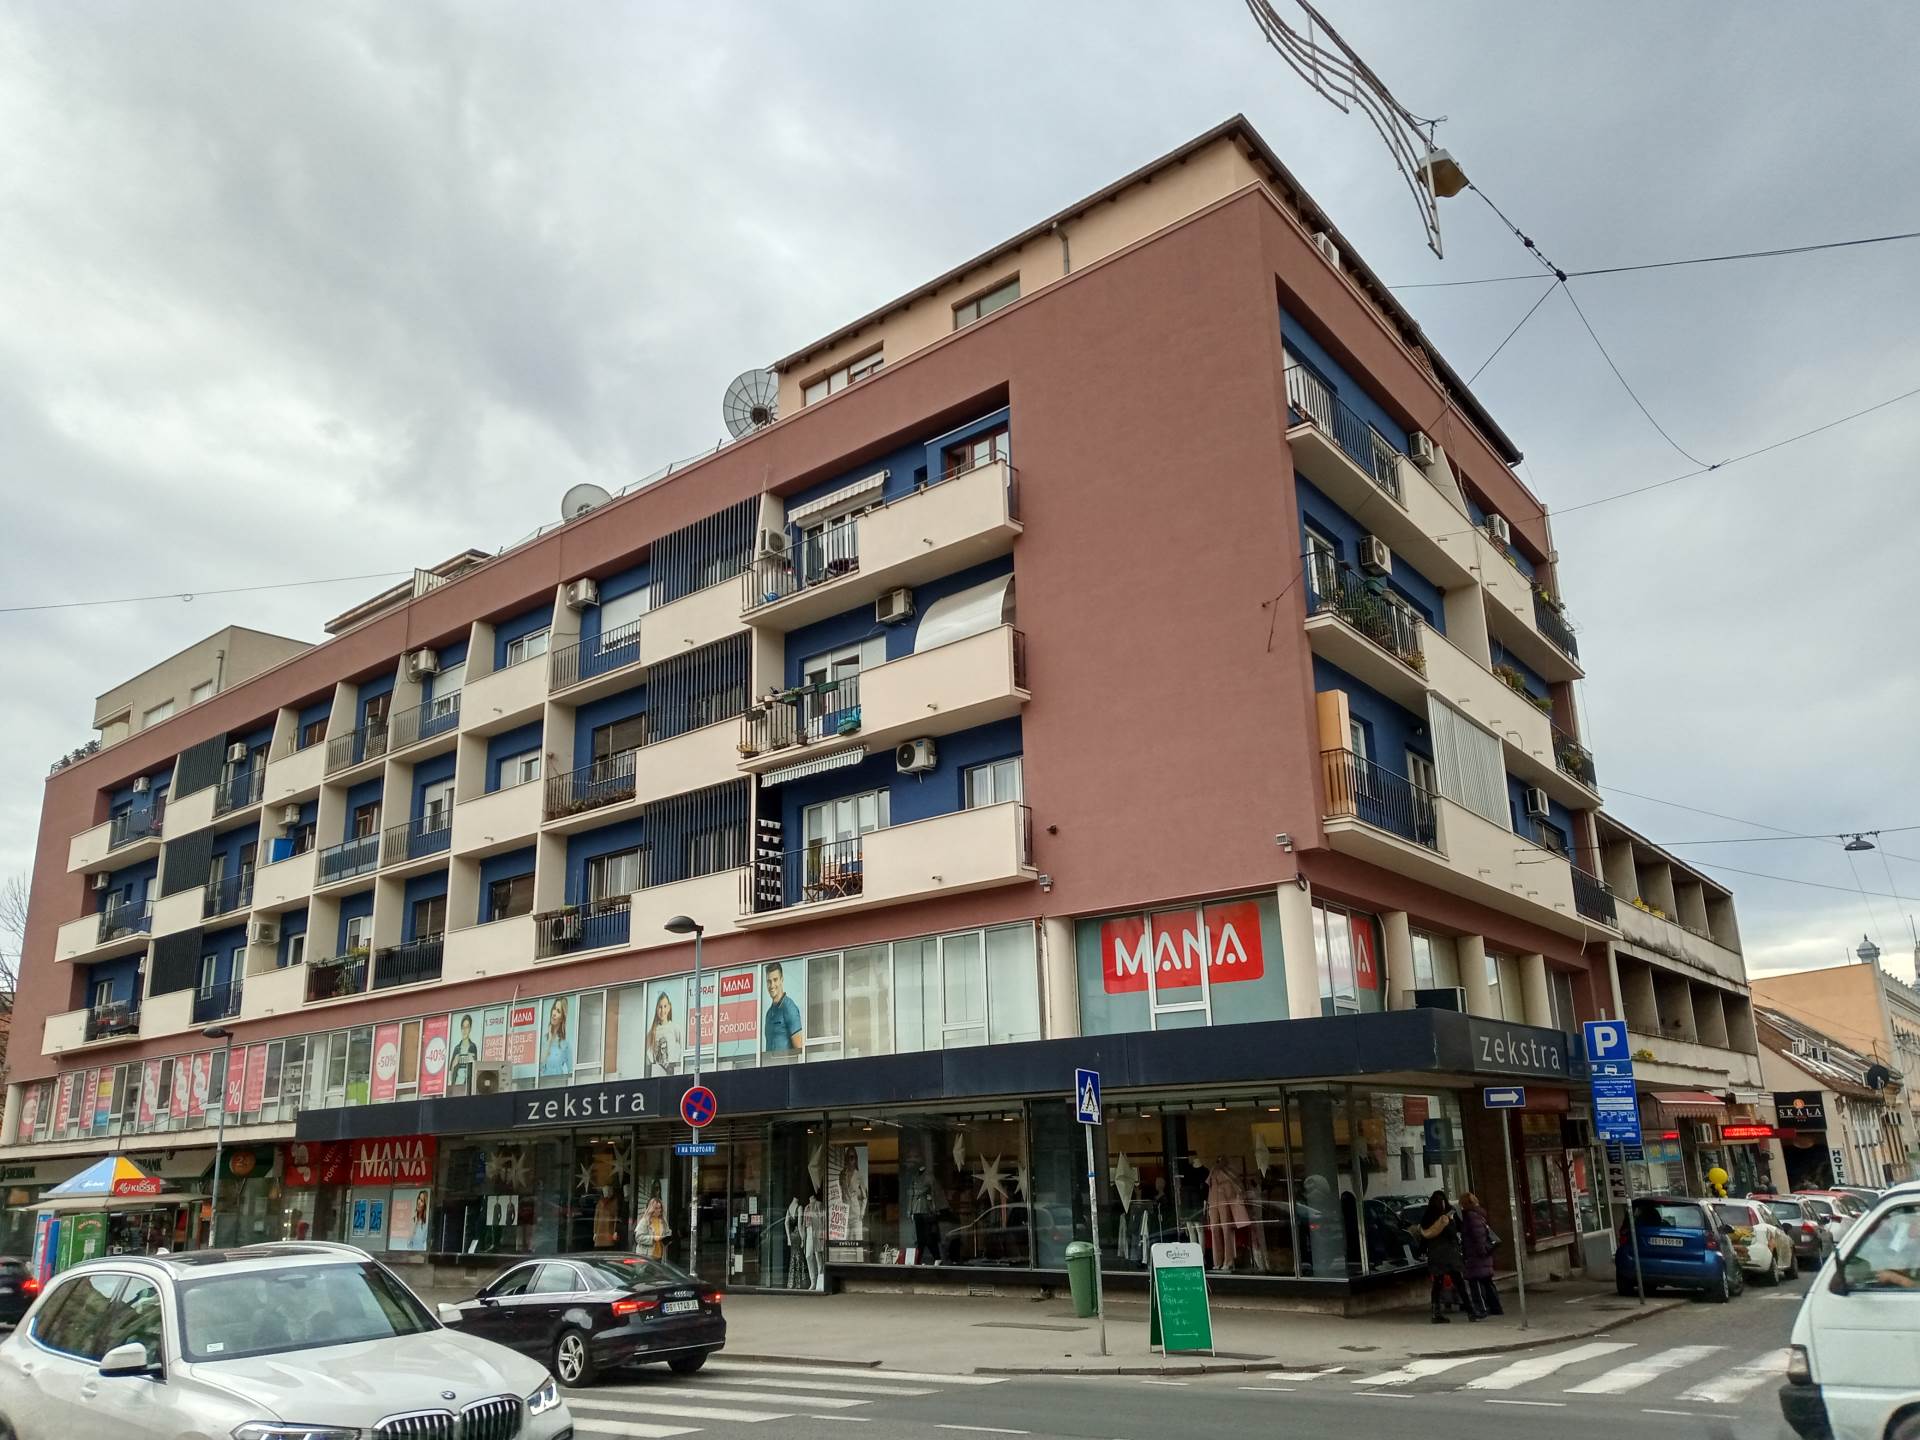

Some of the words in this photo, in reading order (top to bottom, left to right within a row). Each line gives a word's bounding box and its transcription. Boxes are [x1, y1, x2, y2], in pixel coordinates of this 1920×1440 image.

[1115, 922, 1248, 977] MANA
[699, 985, 715, 995] PRAT
[722, 978, 751, 993] MANA
[720, 1012, 729, 1022] ZA
[720, 1020, 757, 1035] PORODICU
[1479, 1031, 1561, 1071] zekstra
[1594, 1026, 1618, 1057] P
[378, 1055, 397, 1068] -50%
[425, 1048, 446, 1062] -40%
[56, 1075, 74, 1130] OUTLET
[84, 1071, 98, 1127] OUTLET
[527, 1092, 645, 1120] zekstra
[1778, 1107, 1823, 1117] SKALA
[360, 1140, 427, 1178] MANA
